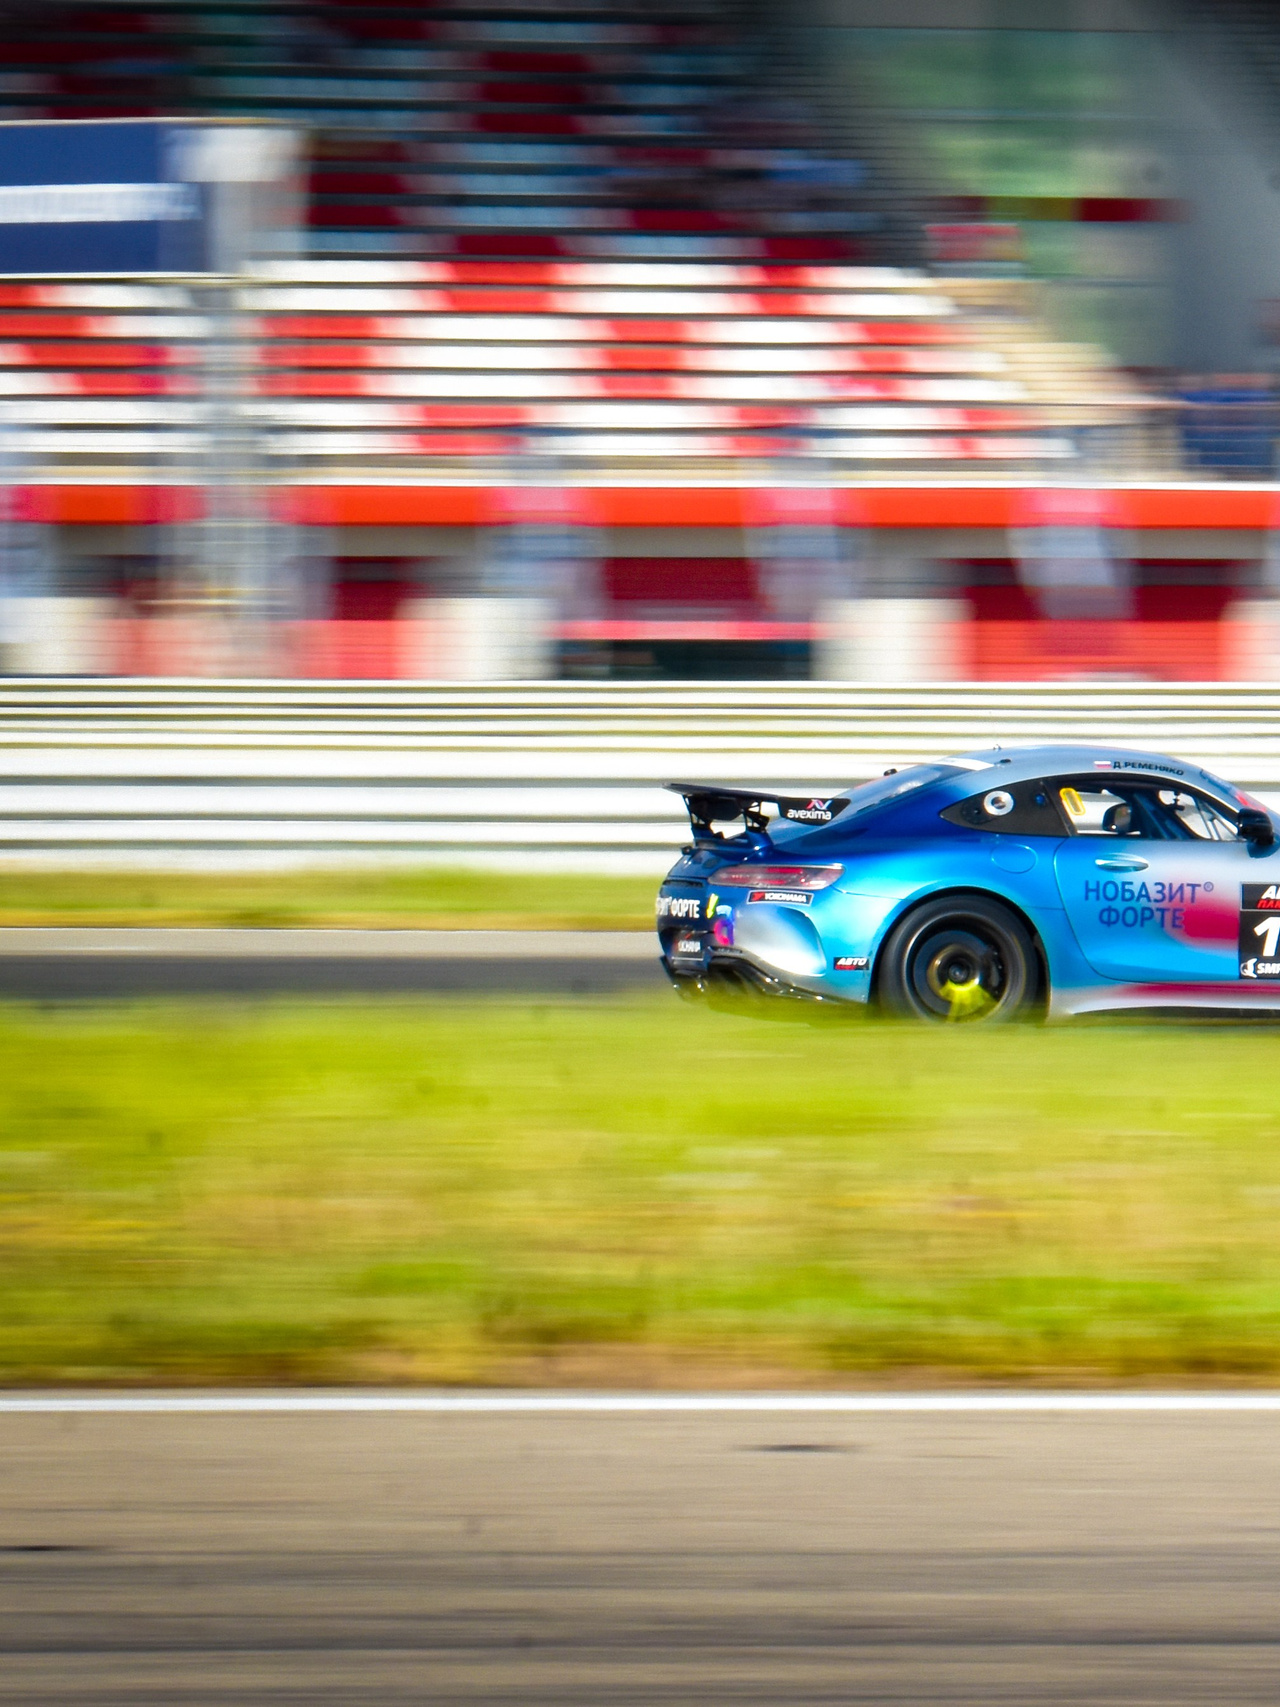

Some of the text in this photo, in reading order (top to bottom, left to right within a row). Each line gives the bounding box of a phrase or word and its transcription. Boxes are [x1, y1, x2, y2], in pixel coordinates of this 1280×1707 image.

[786, 808, 832, 820] avexima
[671, 898, 701, 918] ФОРТЕ
[1098, 905, 1185, 928] ФОРТЕ
[836, 957, 867, 966] АВТО
